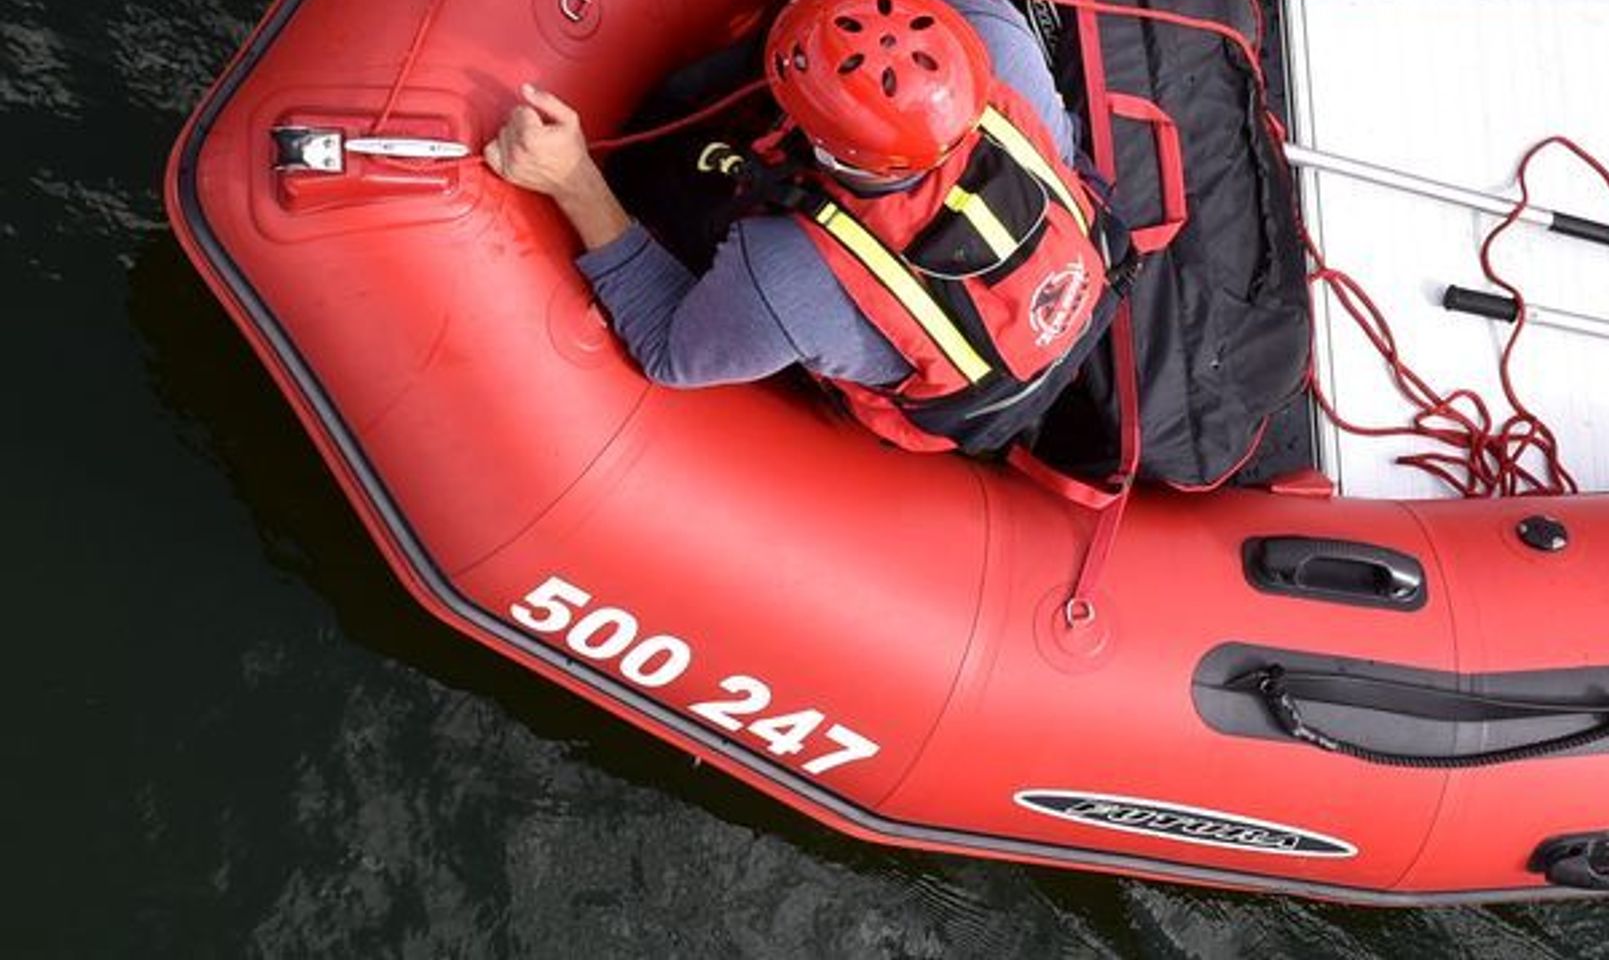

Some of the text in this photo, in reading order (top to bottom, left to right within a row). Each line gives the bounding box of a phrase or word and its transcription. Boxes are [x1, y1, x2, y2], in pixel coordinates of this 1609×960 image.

[508, 575, 881, 778] 500 247
[1064, 797, 1300, 851] FUTURA
